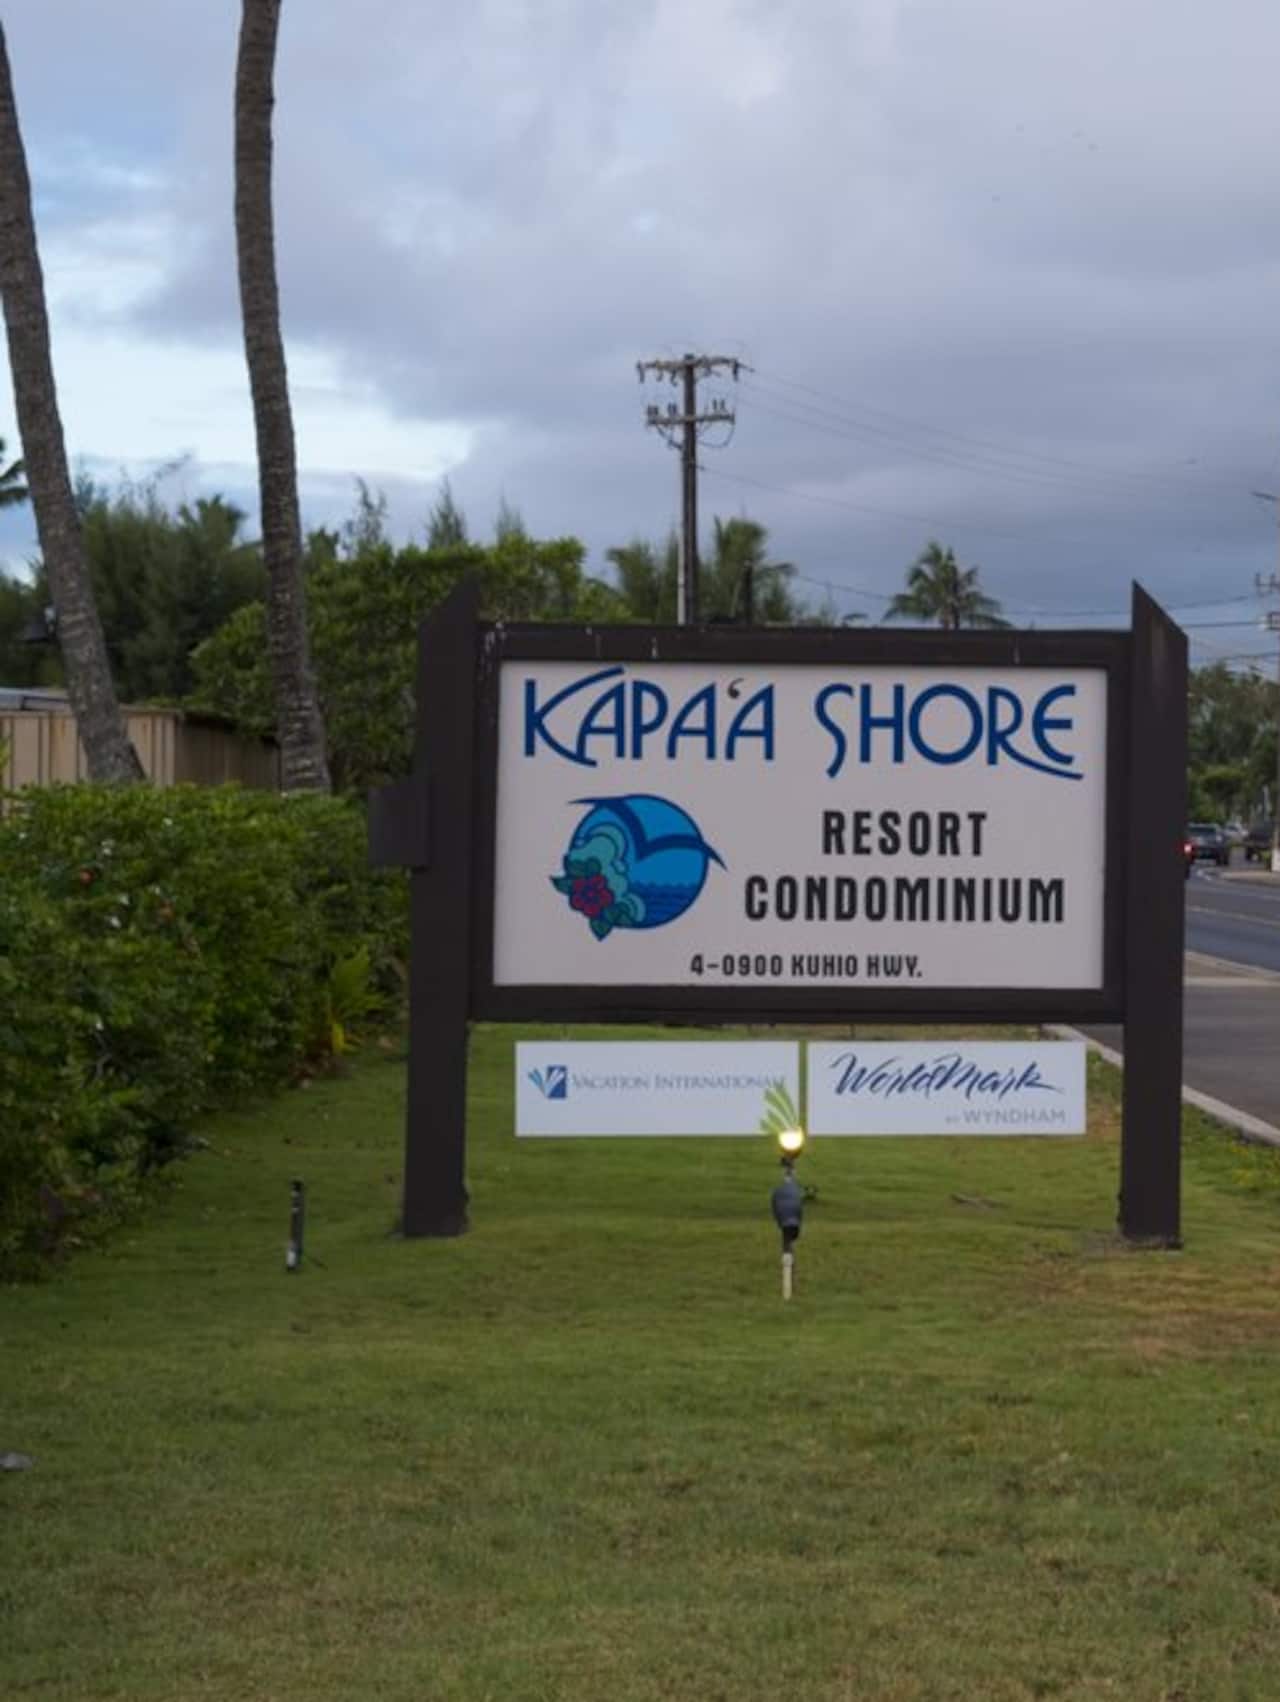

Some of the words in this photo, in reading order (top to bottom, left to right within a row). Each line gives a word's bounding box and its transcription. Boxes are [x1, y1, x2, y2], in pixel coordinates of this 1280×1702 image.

[814, 682, 1084, 780] SHORE
[821, 809, 989, 857] RESORT
[744, 874, 1065, 924] CONDOMINIUM
[689, 953, 784, 978] 4-0900
[790, 953, 859, 979] KUHIO
[866, 954, 924, 979] HWY.
[571, 1073, 650, 1090] VACATION
[829, 1051, 1066, 1102] WorldMark
[963, 1108, 1067, 1125] WYNDHAM
